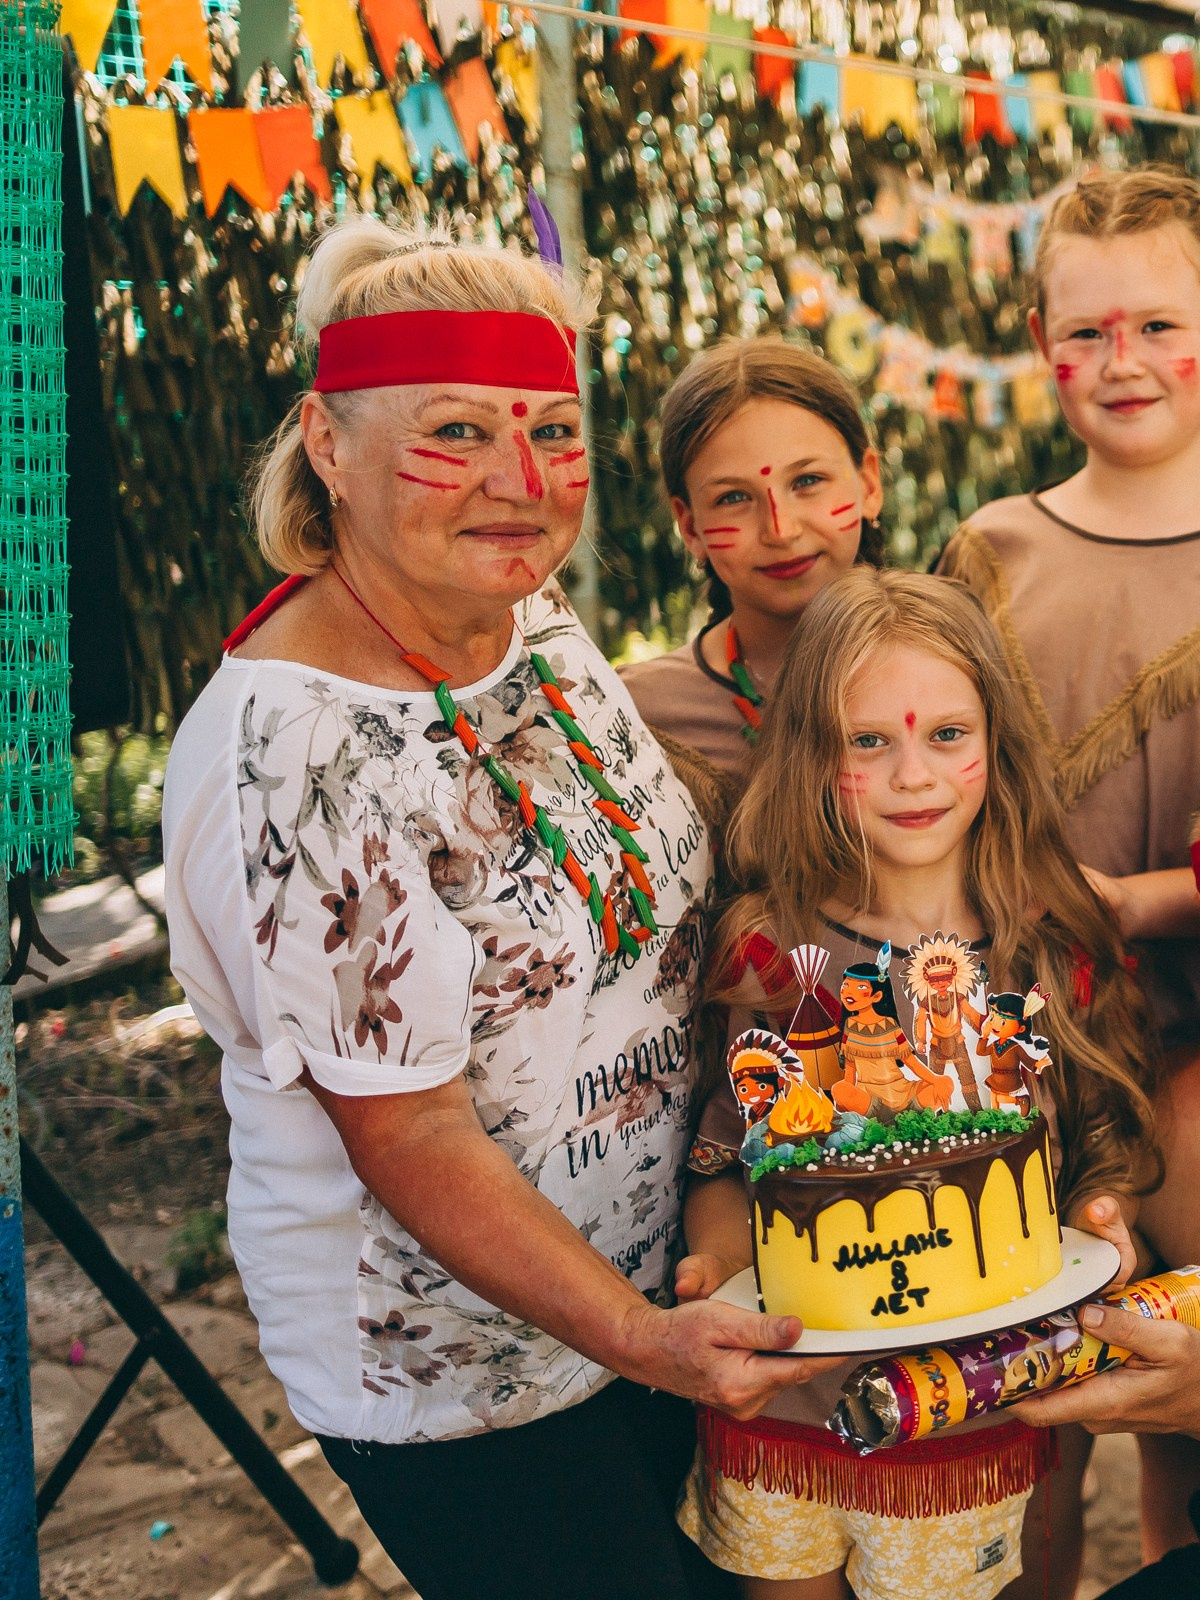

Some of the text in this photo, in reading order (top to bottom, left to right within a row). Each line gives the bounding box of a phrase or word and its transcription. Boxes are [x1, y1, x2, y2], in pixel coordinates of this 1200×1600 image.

[566, 1130, 611, 1179] in
[891, 1260, 909, 1292] 8
[870, 1286, 930, 1316] ЛЕТ
